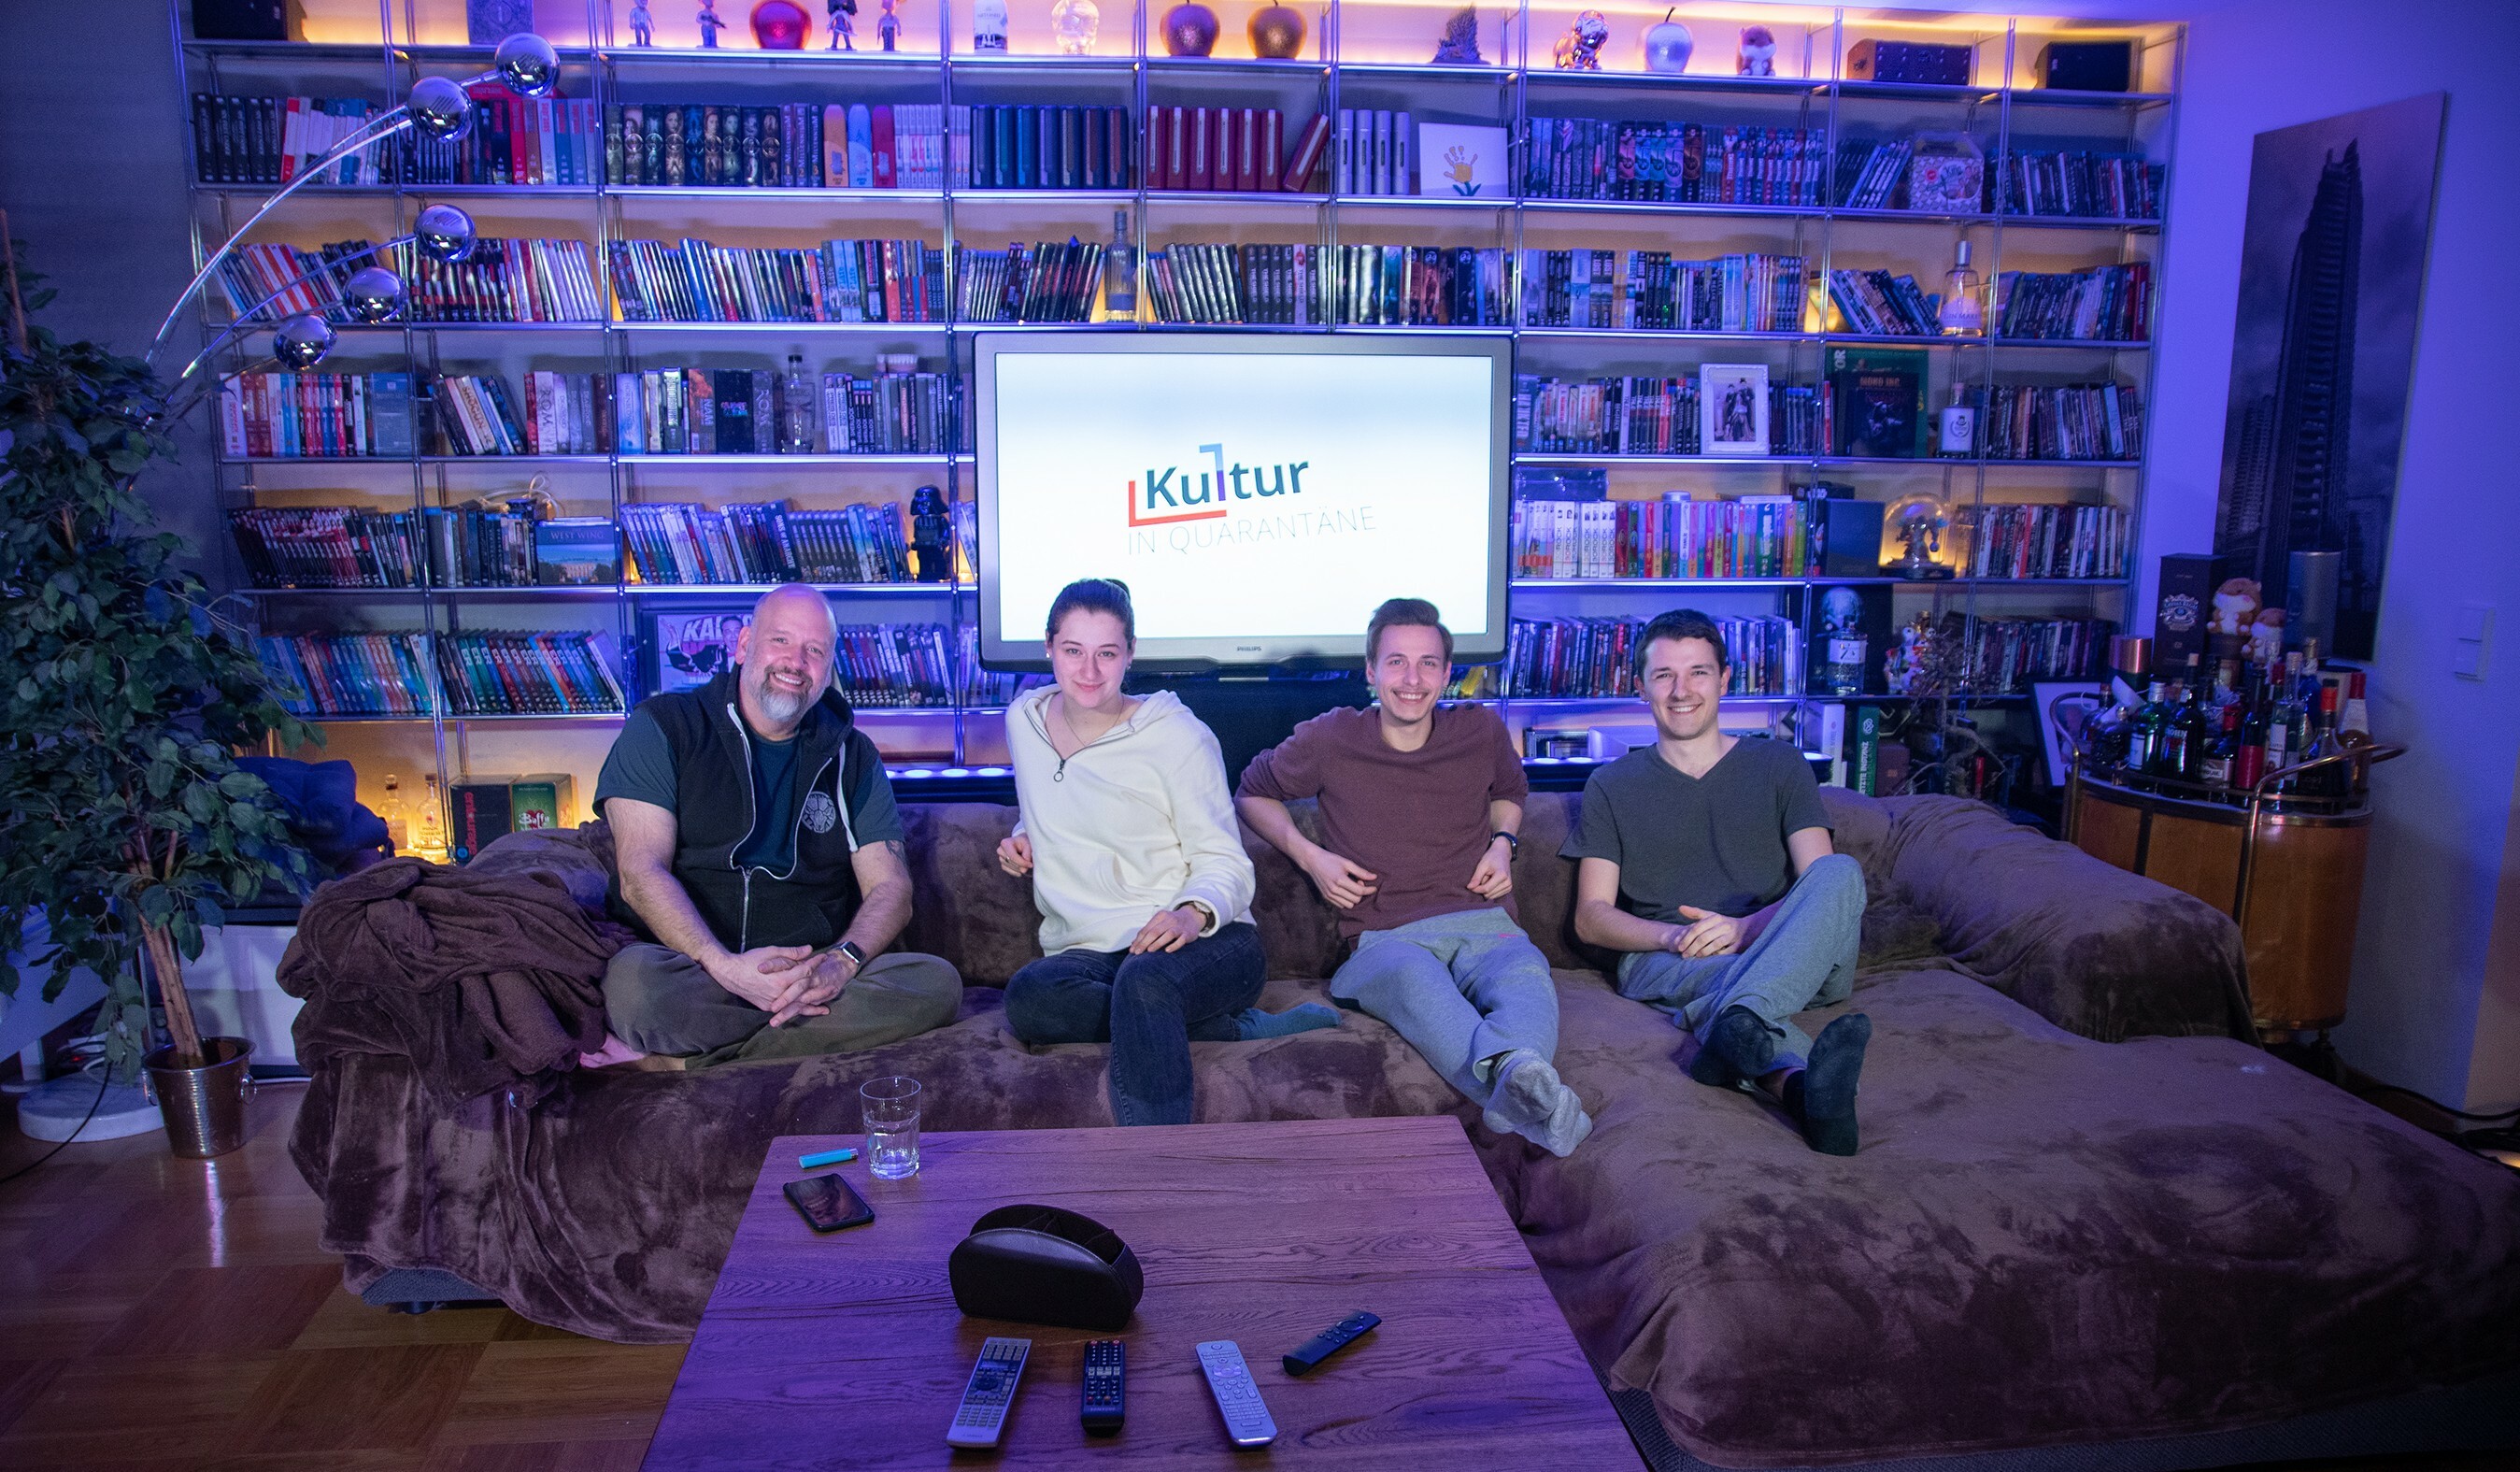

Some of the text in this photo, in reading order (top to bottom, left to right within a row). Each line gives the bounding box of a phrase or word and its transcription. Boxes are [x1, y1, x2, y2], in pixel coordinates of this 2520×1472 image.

[1146, 443, 1310, 509] Kultur
[550, 530, 605, 540] WEST WING
[1128, 506, 1377, 555] IN QUARANTÄNE
[781, 538, 796, 569] ANARCHY
